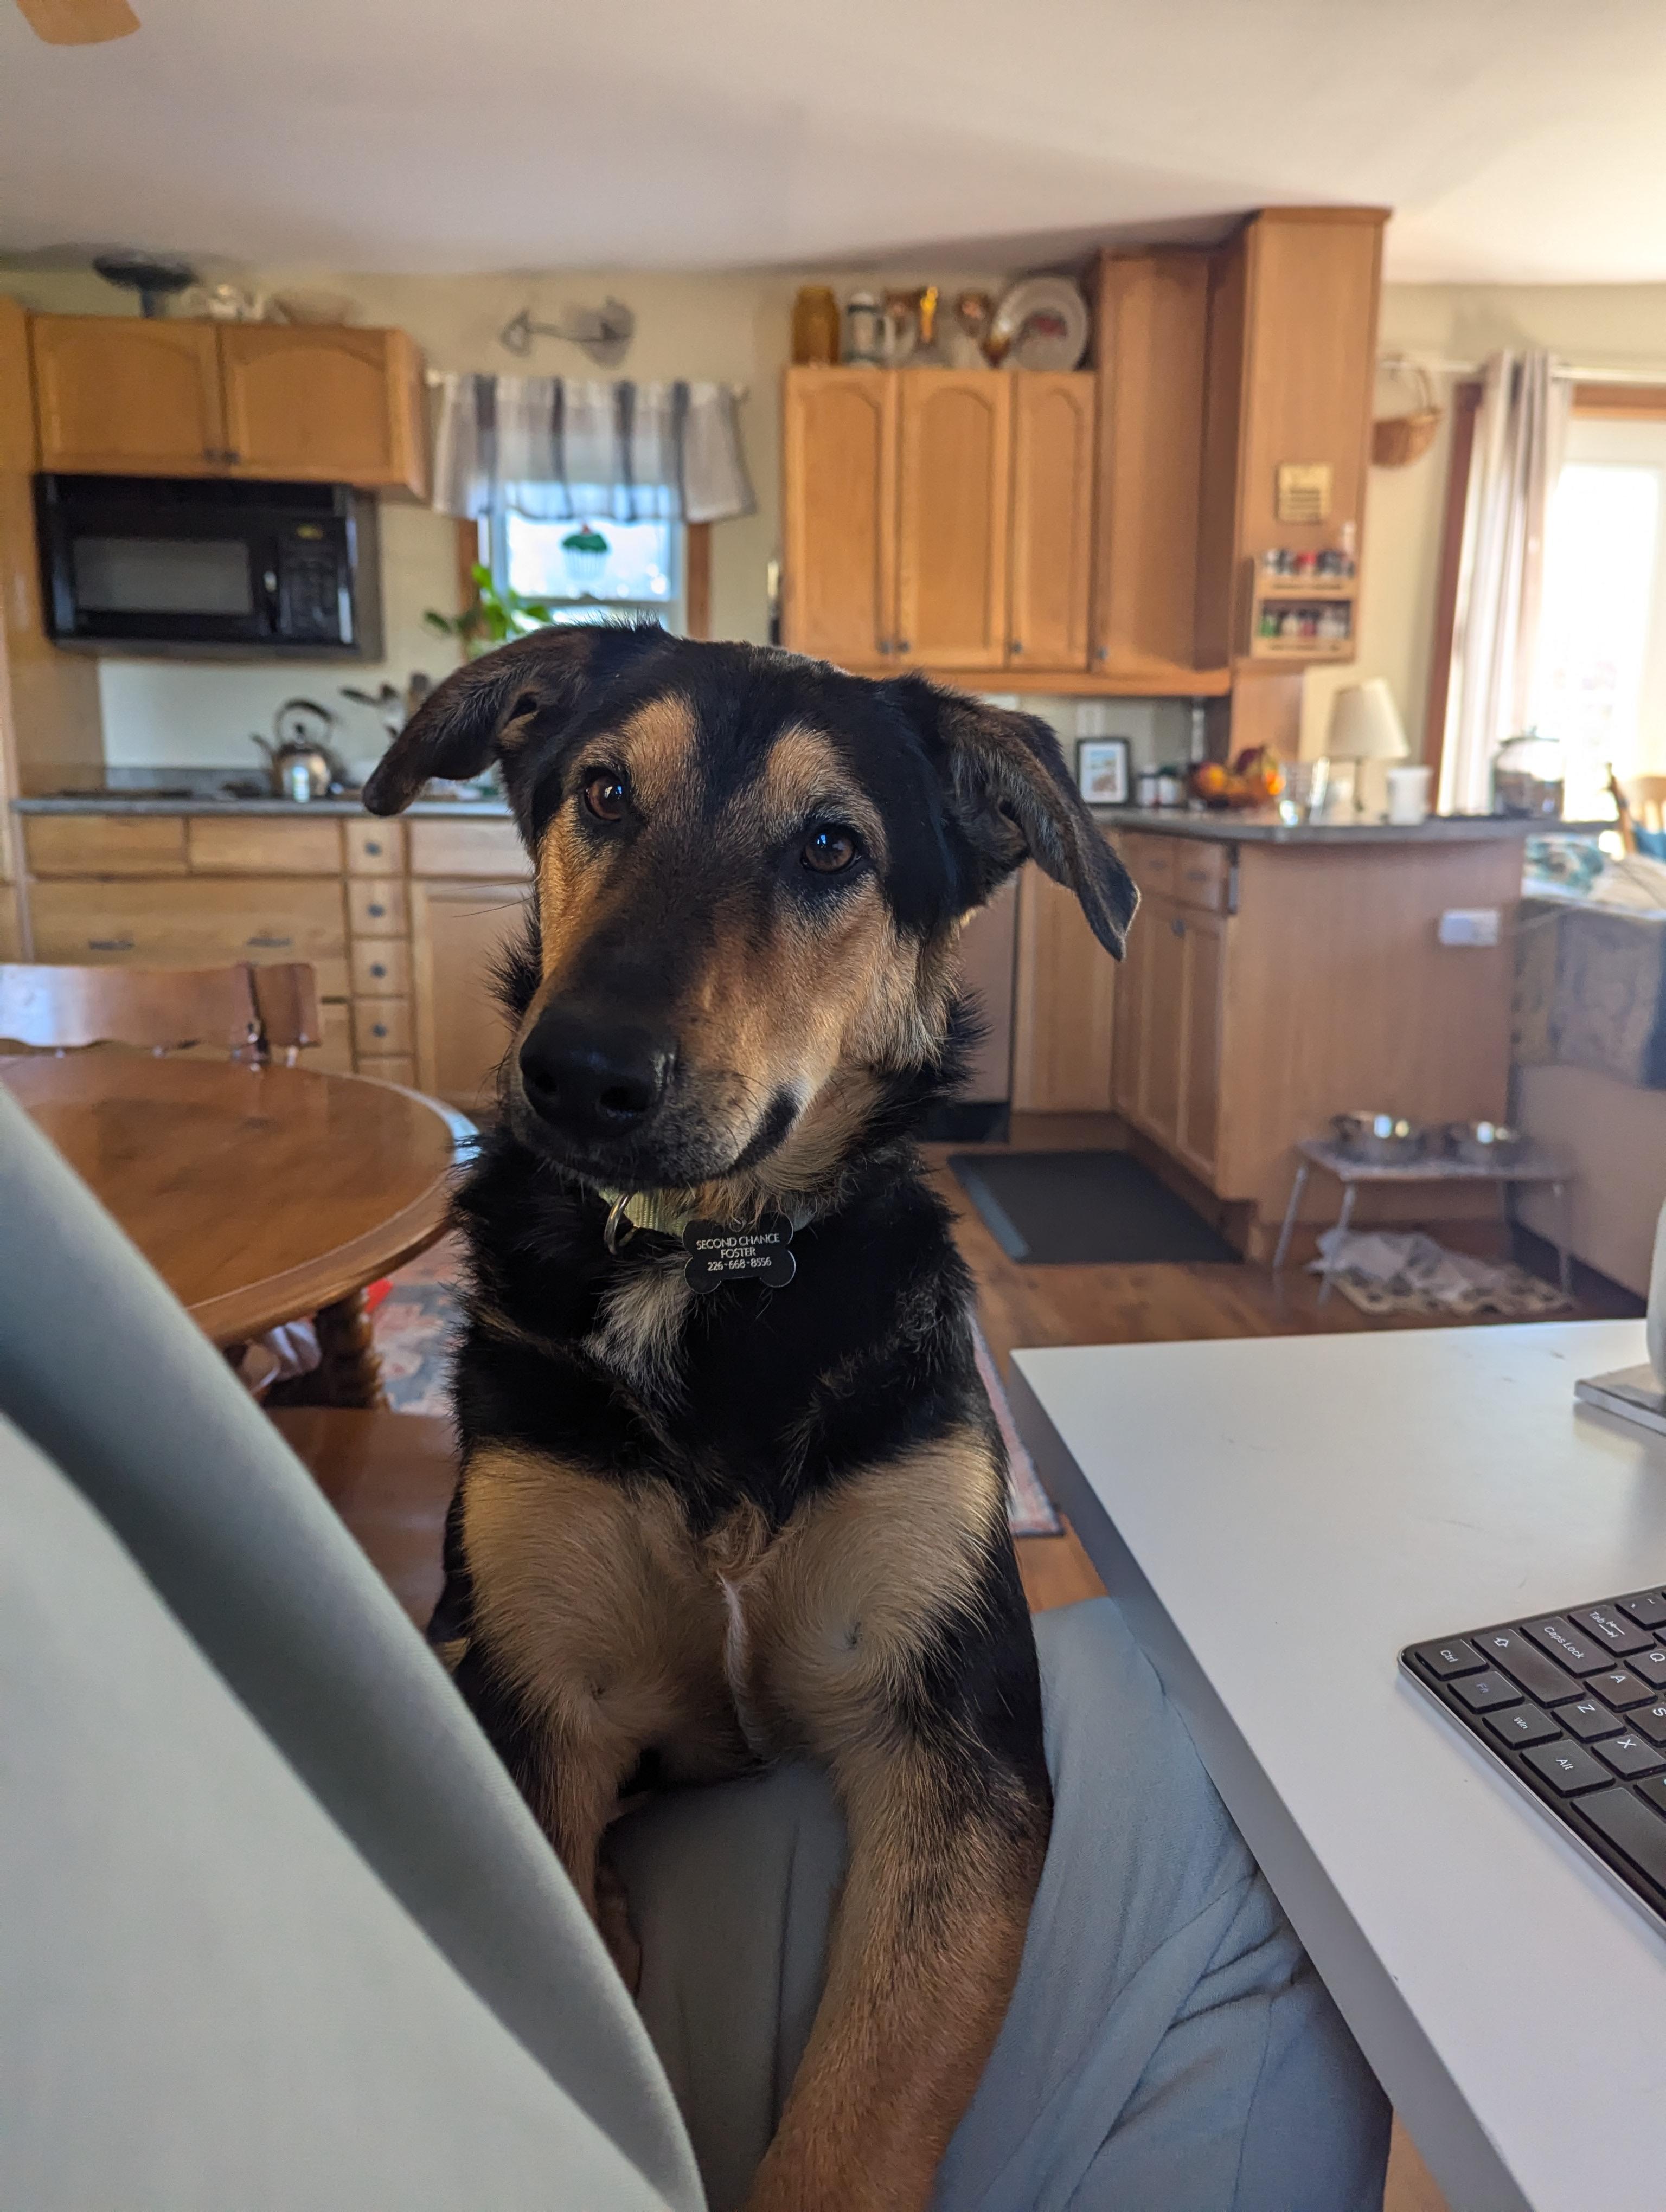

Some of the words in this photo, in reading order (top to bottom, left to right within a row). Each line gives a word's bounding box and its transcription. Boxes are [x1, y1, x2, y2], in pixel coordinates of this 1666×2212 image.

[696, 1237, 737, 1250] SECOND
[739, 1233, 780, 1246] CHANCE
[721, 1247, 756, 1259] FOSTER
[707, 1257, 772, 1271] 226-668-8556
[1589, 1611, 1605, 1623] Tab
[1543, 1626, 1565, 1644] Caps
[1563, 1642, 1584, 1658] Lock
[1440, 1650, 1458, 1662] Ctrl
[1650, 1653, 1665, 1662] Q
[1610, 1675, 1626, 1683] A
[1476, 1682, 1489, 1693] Fn
[1577, 1704, 1595, 1713] Z
[1514, 1716, 1528, 1729] Win
[1617, 1739, 1637, 1749] X
[1555, 1758, 1573, 1770] Alt
